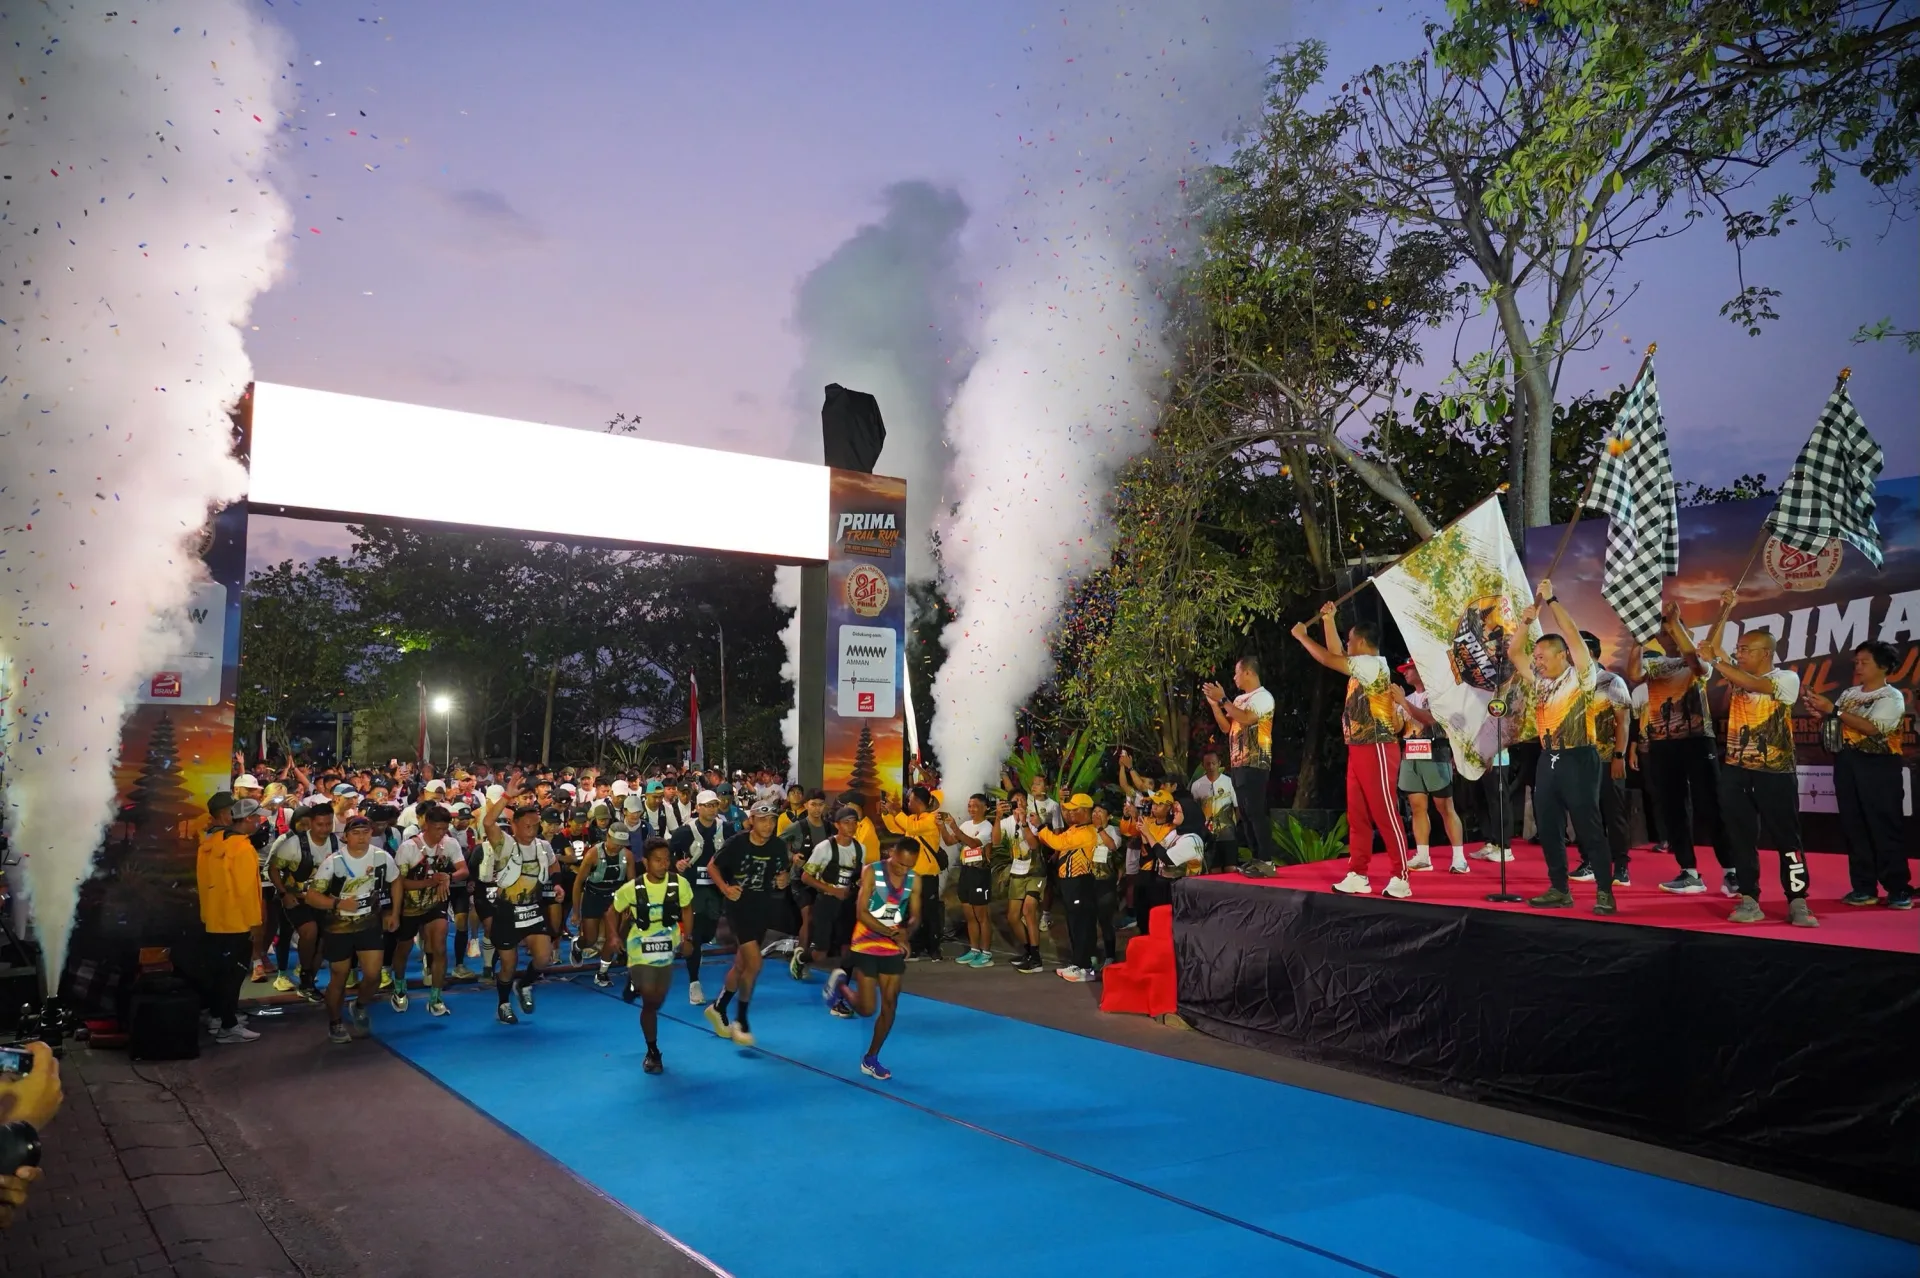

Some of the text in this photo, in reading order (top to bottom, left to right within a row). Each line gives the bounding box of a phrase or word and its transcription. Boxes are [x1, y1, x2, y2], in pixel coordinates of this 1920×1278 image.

[836, 513, 896, 543] PRIMA
[846, 530, 900, 541] TRAIL RUN
[1785, 570, 1822, 580] PRIMA
[1453, 631, 1497, 679] PRIMA
[1408, 744, 1428, 753] 82075
[1785, 851, 1806, 893] FILA
[645, 942, 669, 952] 81072
